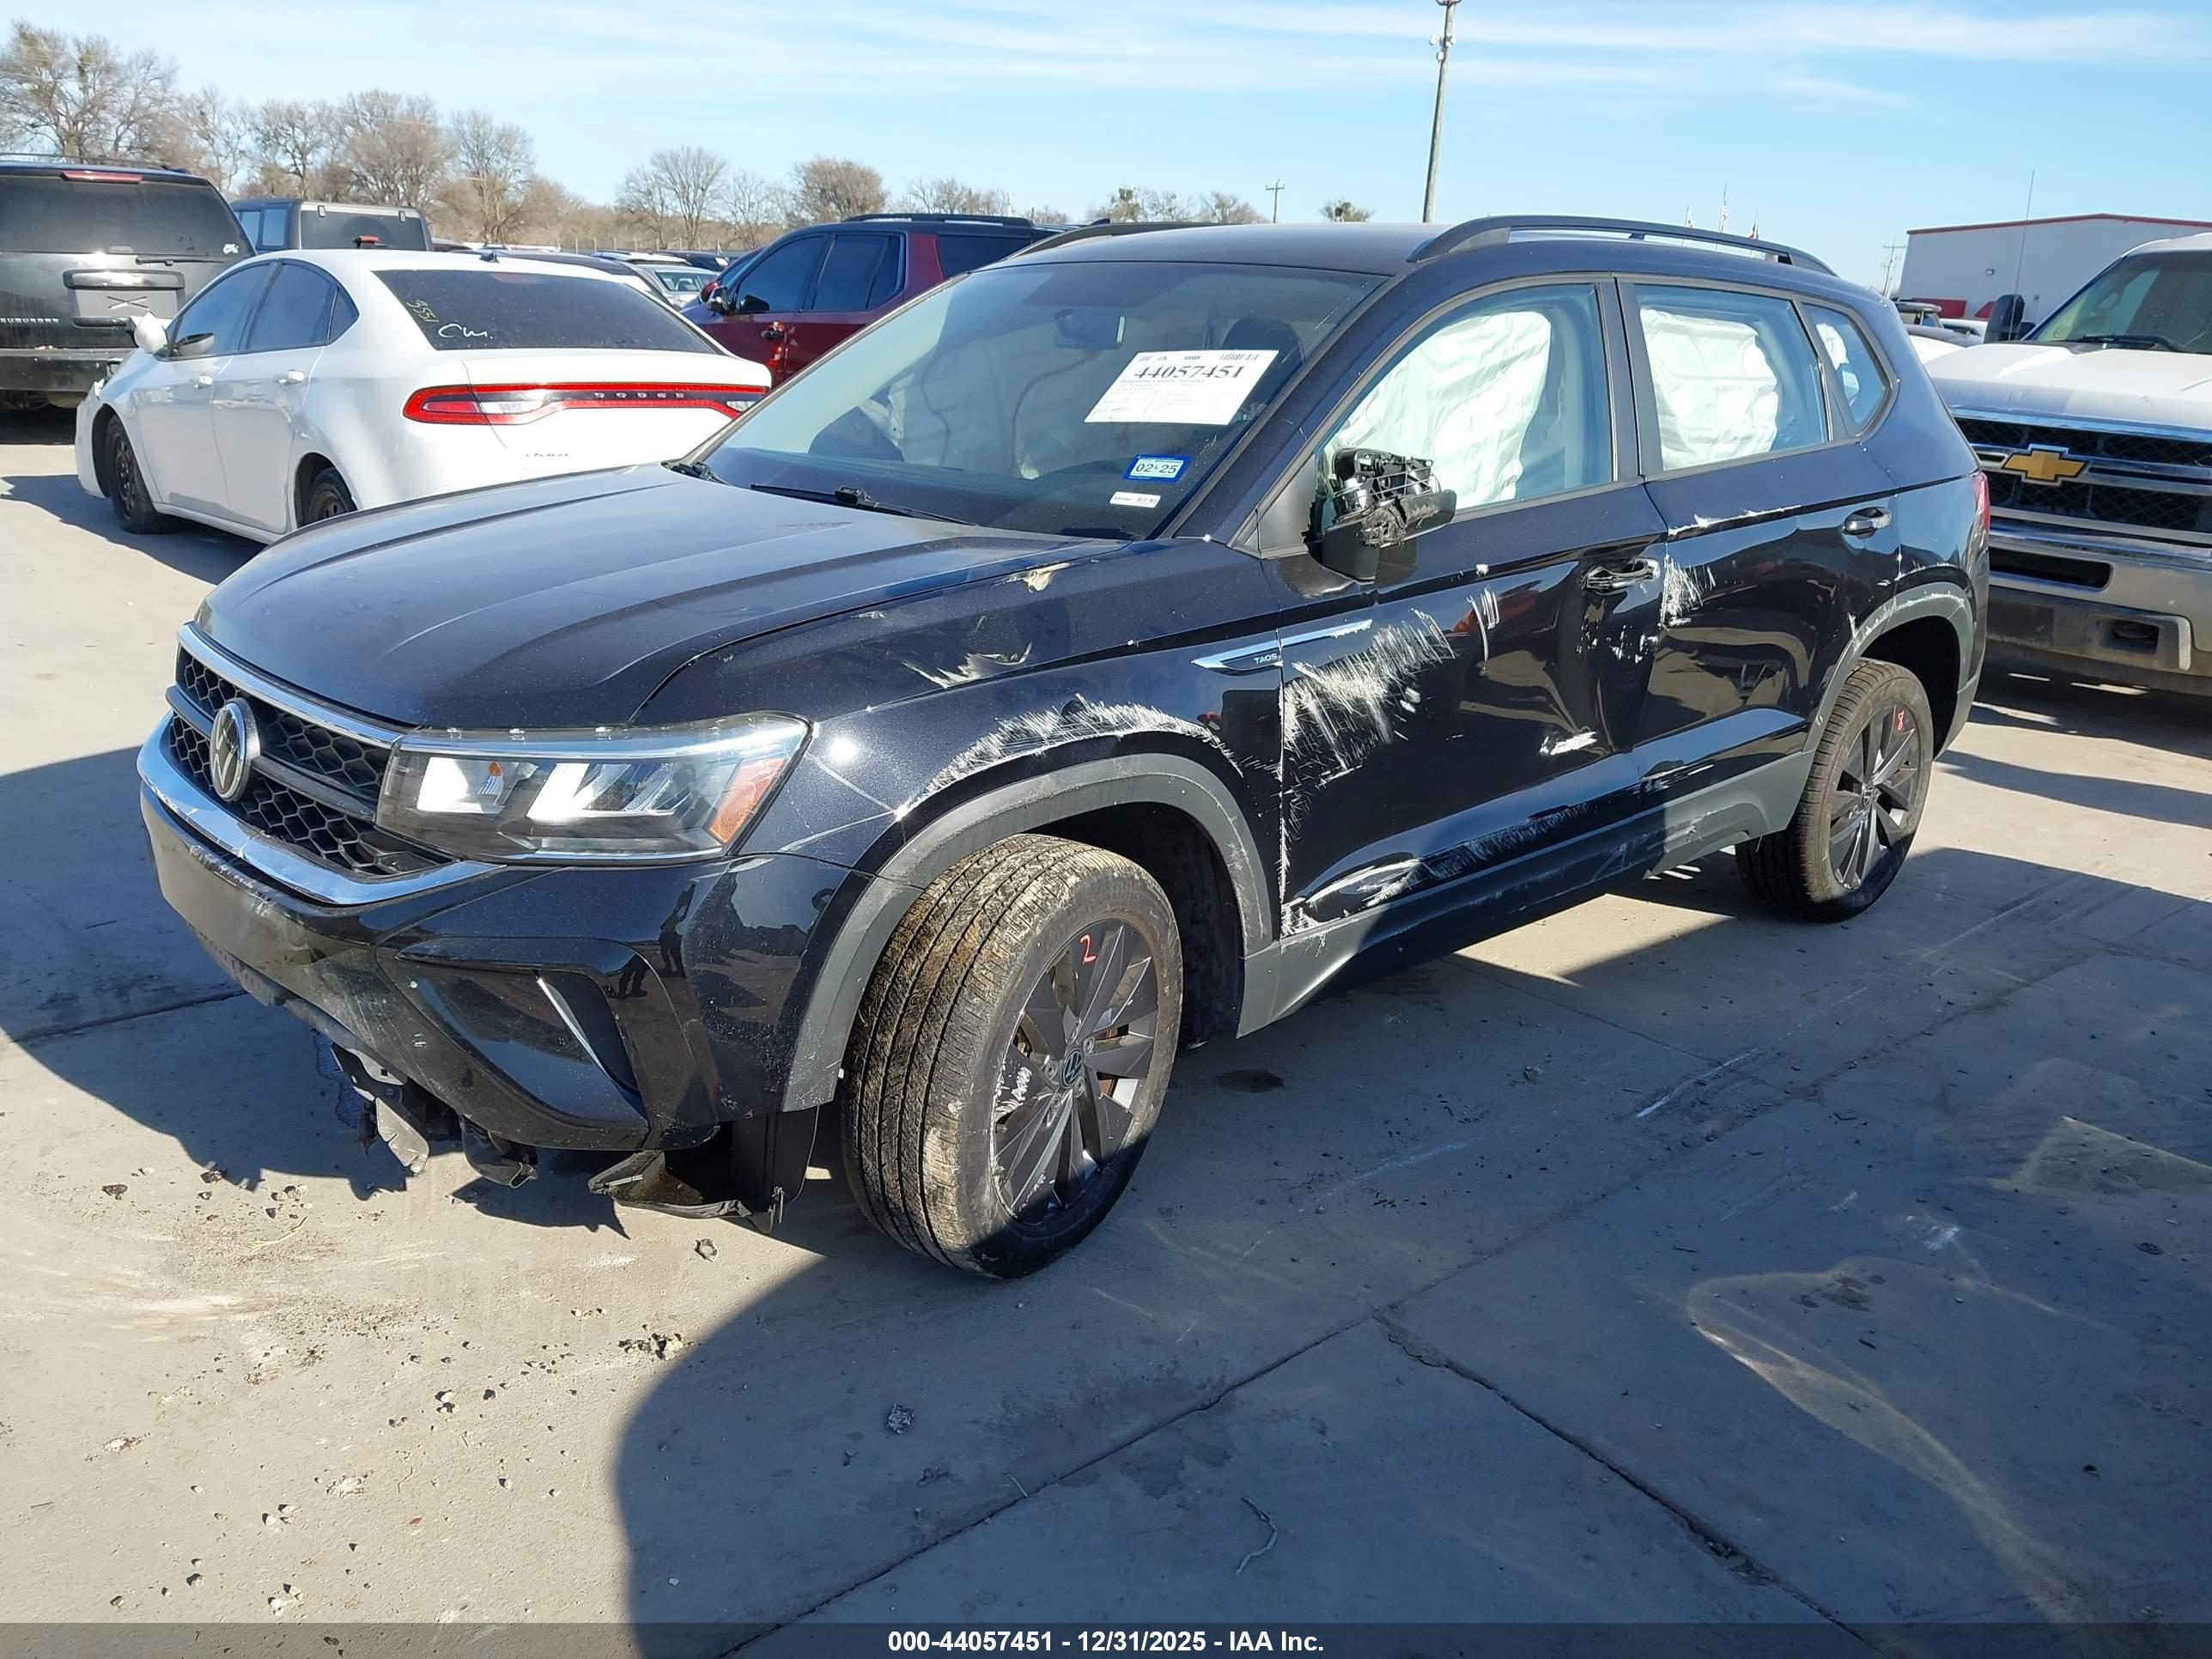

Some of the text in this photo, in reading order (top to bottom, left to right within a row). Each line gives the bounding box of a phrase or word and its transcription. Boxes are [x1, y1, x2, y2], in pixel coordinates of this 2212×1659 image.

[1134, 366, 1244, 378] 44057451
[1135, 464, 1178, 473] 02 25
[1253, 653, 1278, 665] TAOS
[1079, 934, 1097, 963] 2
